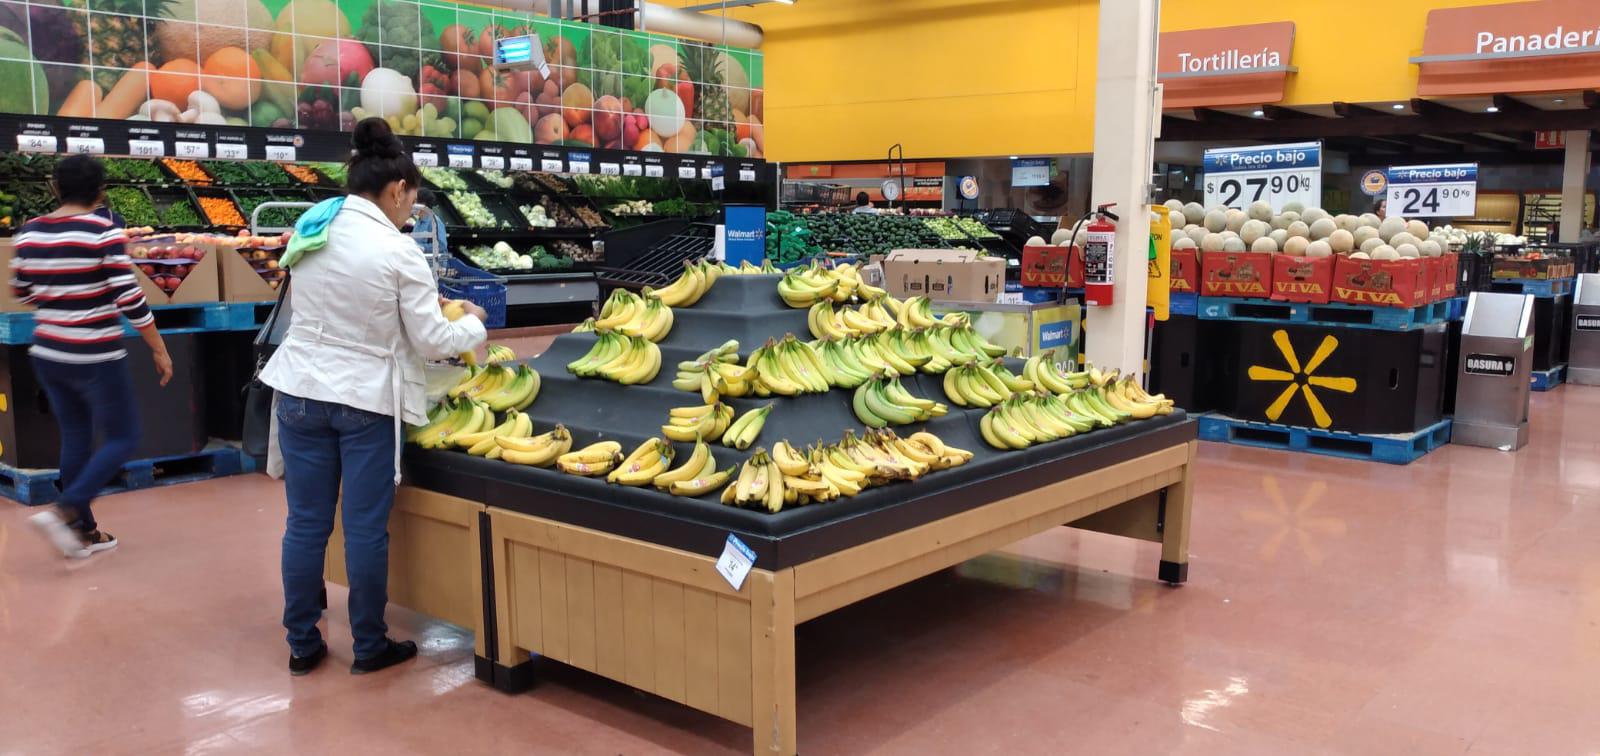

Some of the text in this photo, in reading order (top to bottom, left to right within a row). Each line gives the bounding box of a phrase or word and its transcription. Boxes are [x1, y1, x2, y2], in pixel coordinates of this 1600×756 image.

[1178, 48, 1280, 73] Tortillería
[1230, 150, 1306, 166] Precio bajo
[1408, 168, 1467, 179] Precio bajo
[1206, 182, 1215, 194] $
[1219, 177, 1268, 210] 27
[1393, 190, 1400, 200] $
[1402, 187, 1440, 214] 24
[727, 230, 755, 238] Walmart
[1025, 272, 1075, 283] VIVA
[1206, 281, 1266, 293] VIVA
[1275, 282, 1324, 294] VIVA
[1335, 287, 1404, 304] VIVA
[1042, 329, 1064, 342] Walmart
[1467, 358, 1504, 371] BASURA
